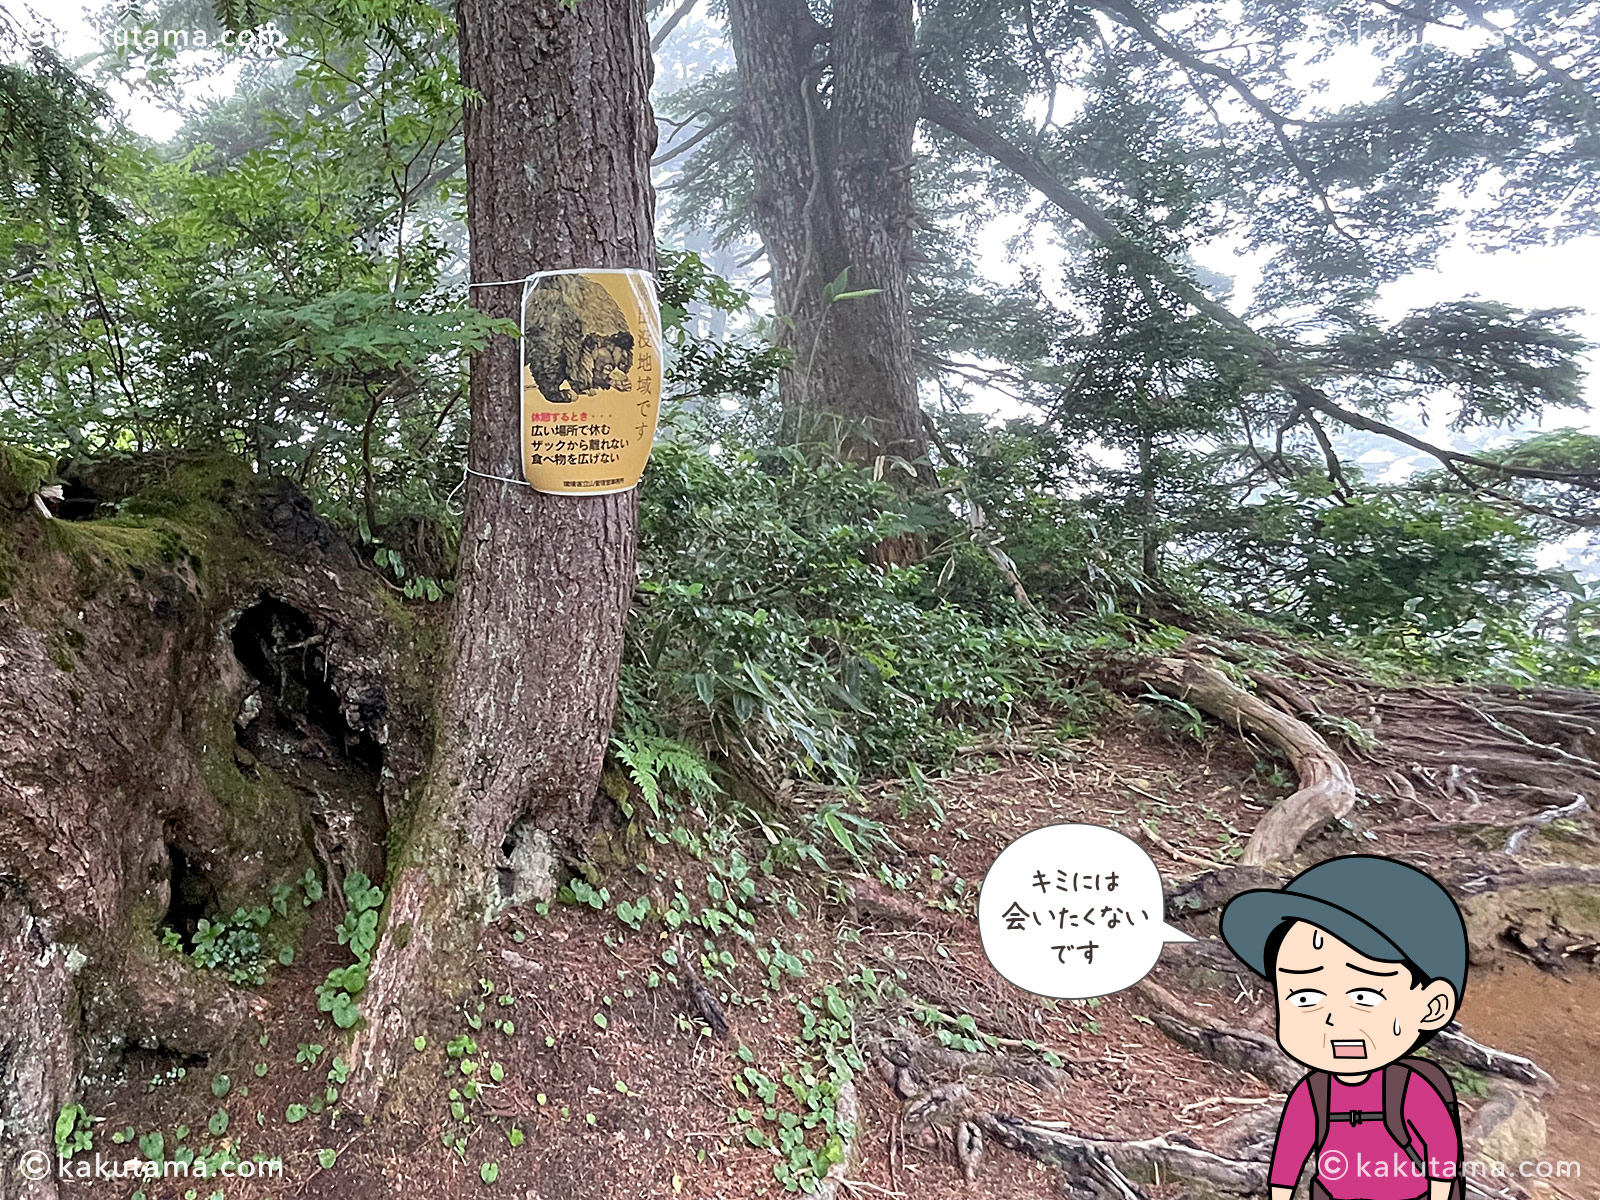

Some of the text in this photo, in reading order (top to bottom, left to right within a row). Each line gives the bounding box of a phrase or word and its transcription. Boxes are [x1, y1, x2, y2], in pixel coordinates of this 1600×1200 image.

[531, 424, 611, 437] 広い場所で休む
[531, 438, 629, 451] ザックから離れない
[531, 452, 620, 465] 食べ物を広げない
